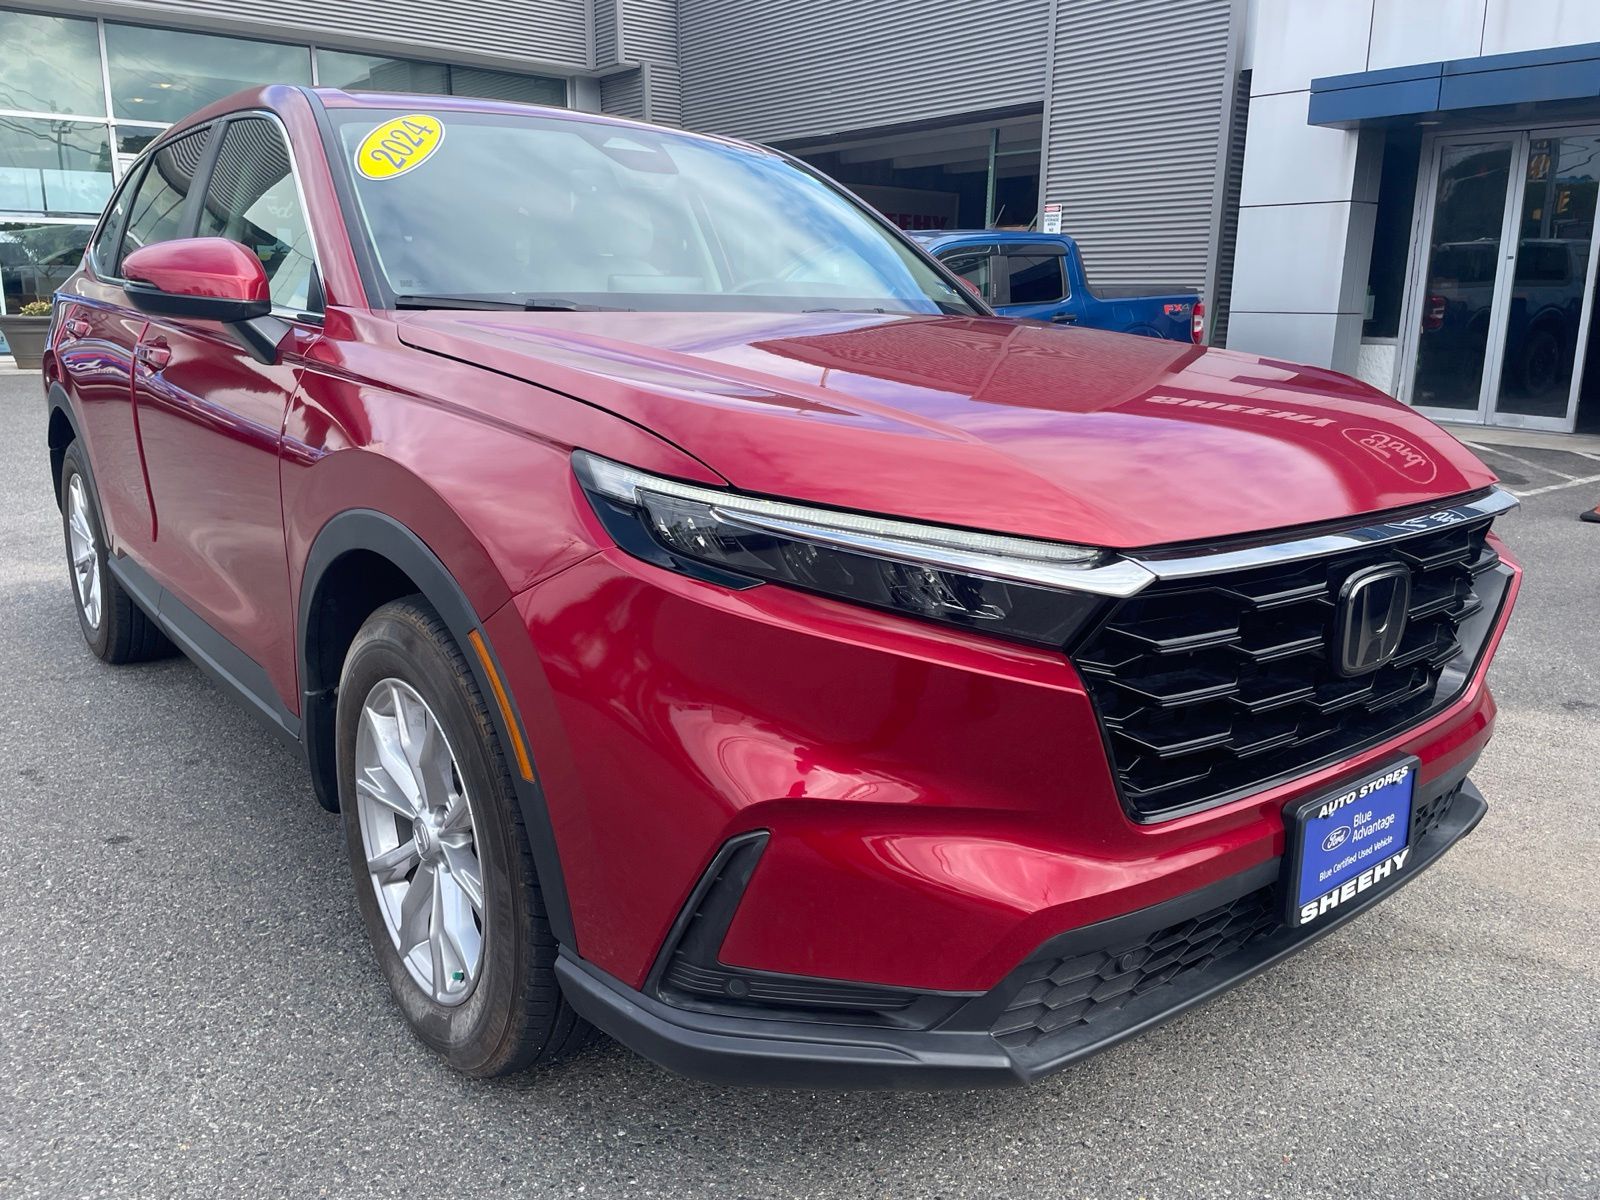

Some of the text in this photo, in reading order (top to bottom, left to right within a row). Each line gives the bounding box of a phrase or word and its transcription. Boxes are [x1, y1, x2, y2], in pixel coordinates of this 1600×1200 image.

[371, 120, 434, 169] 2024
[1163, 303, 1190, 315] FX4
[1318, 765, 1409, 819] AUTO STORES
[1351, 813, 1395, 843] Advantage
[1353, 810, 1373, 828] Blue
[1319, 835, 1393, 882] Blue Certified Used Vehicle
[1300, 848, 1410, 925] SHEEHY
